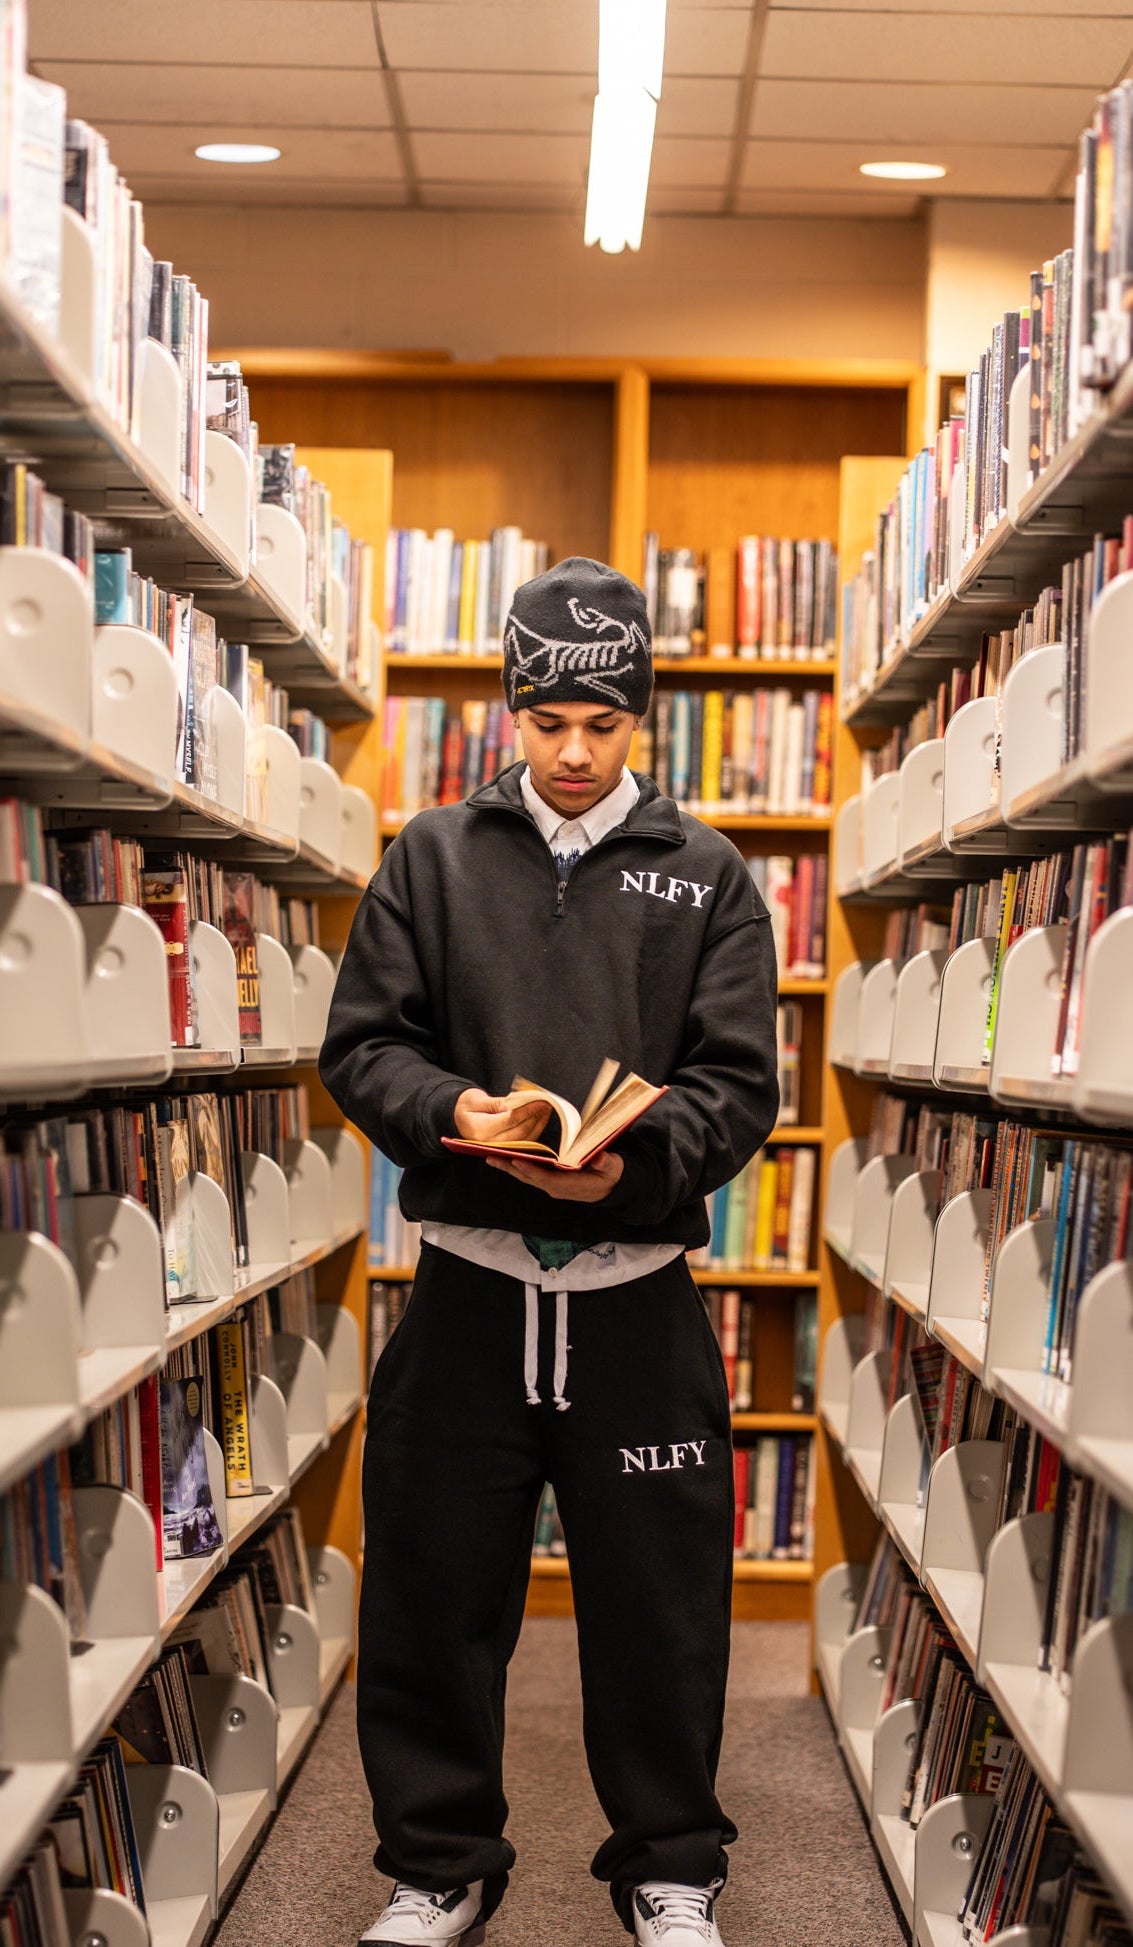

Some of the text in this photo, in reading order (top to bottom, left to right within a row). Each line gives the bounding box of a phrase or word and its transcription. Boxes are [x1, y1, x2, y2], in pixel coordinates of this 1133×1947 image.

[619, 870, 713, 908] NLFY
[222, 1331, 233, 1381] CONNOLLY
[230, 1342, 238, 1369] JOHN
[233, 1391, 243, 1416] THE
[223, 1393, 237, 1471] OF ANGELS
[236, 1423, 247, 1472] WRATH
[618, 1439, 707, 1473] NLFY
[991, 1745, 1002, 1759] J
